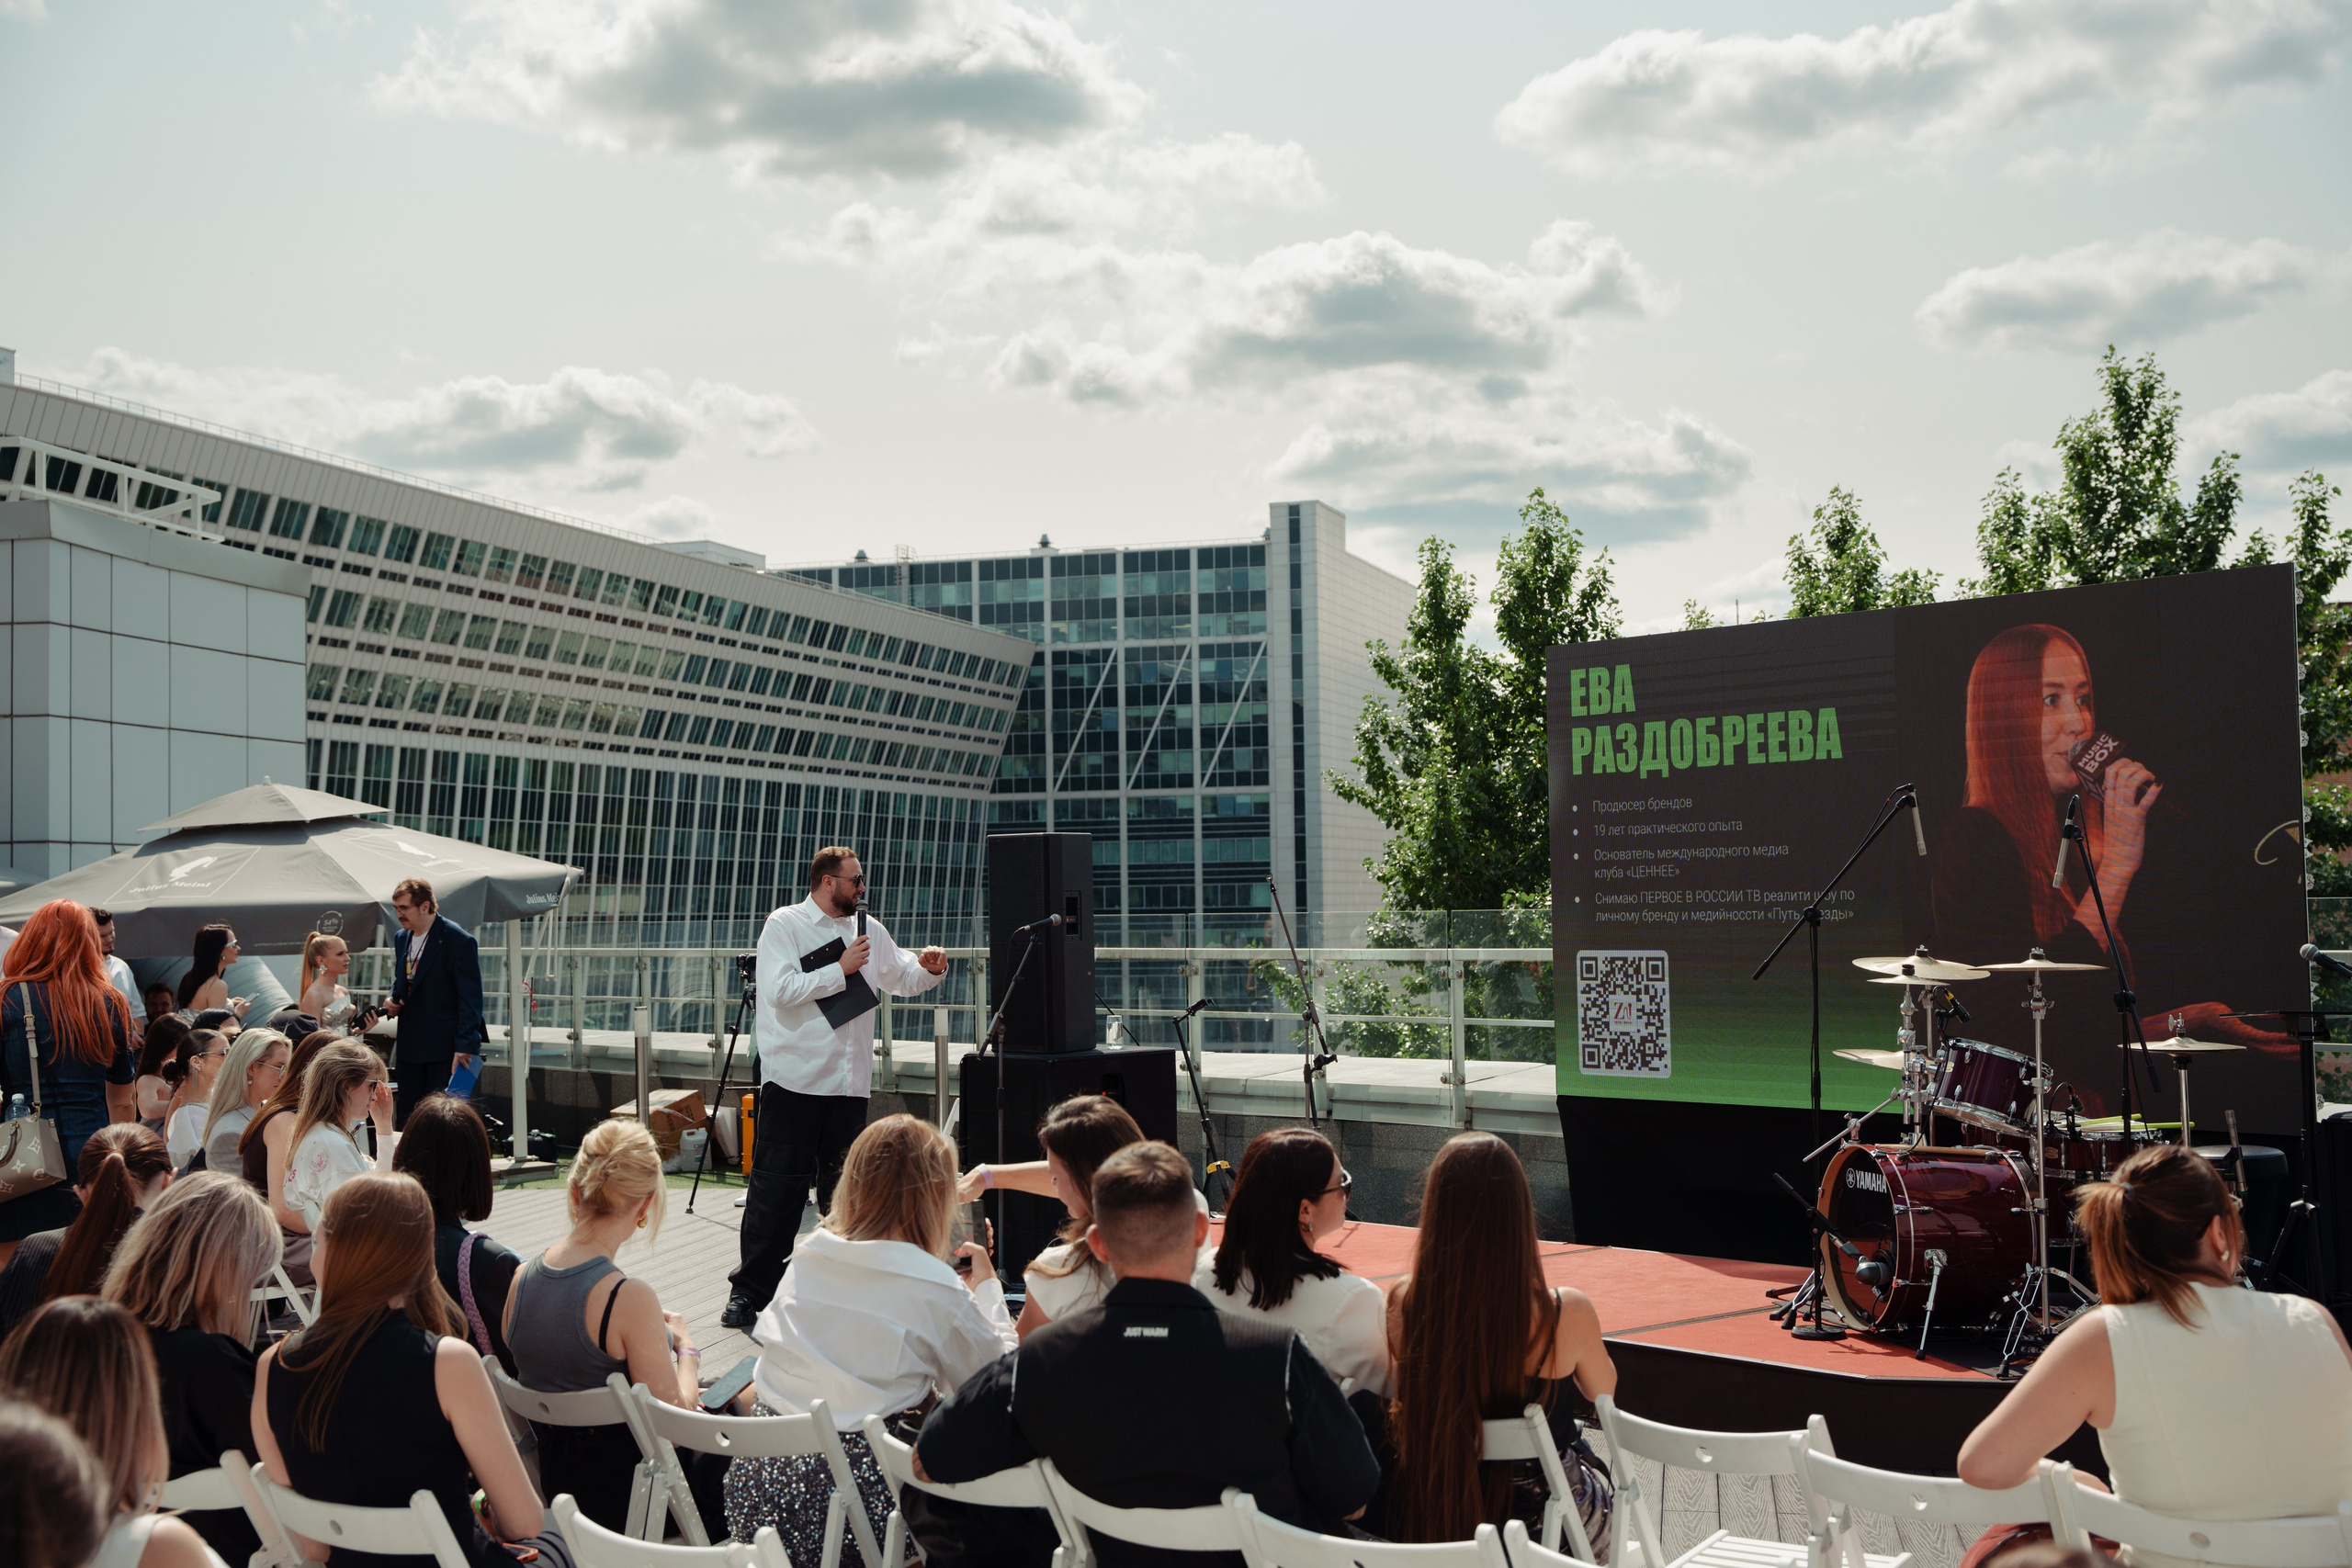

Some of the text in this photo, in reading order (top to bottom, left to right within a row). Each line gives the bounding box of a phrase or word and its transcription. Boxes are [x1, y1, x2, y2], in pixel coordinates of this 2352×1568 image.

[1570, 663, 1636, 717] ЕВА
[1571, 707, 1843, 779] РАЗДОБРЕЕВА
[2077, 734, 2109, 768] MUSIC
[2084, 738, 2120, 773] BOX
[1592, 797, 1692, 815] Продюсер брендов
[1594, 820, 1743, 837] 19 лет практического опыта
[1594, 844, 1789, 862] Основатель международного медиа
[1594, 864, 1680, 881] клуба «ЦЕННЕЕ»
[129, 881, 212, 894] Julius Meinl
[526, 894, 548, 905] Julius
[1595, 892, 1638, 905] Снимаю
[1640, 891, 1683, 904] ПЕРВОЕ
[1686, 890, 1693, 903] В
[1695, 889, 1743, 903] РОССИИ
[1747, 889, 1761, 902] ТВ
[1763, 890, 1811, 905] реалити
[1840, 889, 1855, 900] по
[1595, 911, 1640, 924] личному
[1642, 908, 1679, 924] бренду
[1681, 910, 1689, 920] и
[1768, 907, 1801, 923] «Путь
[1815, 908, 1854, 921] езды»
[1855, 1169, 1887, 1193] YAMAHA
